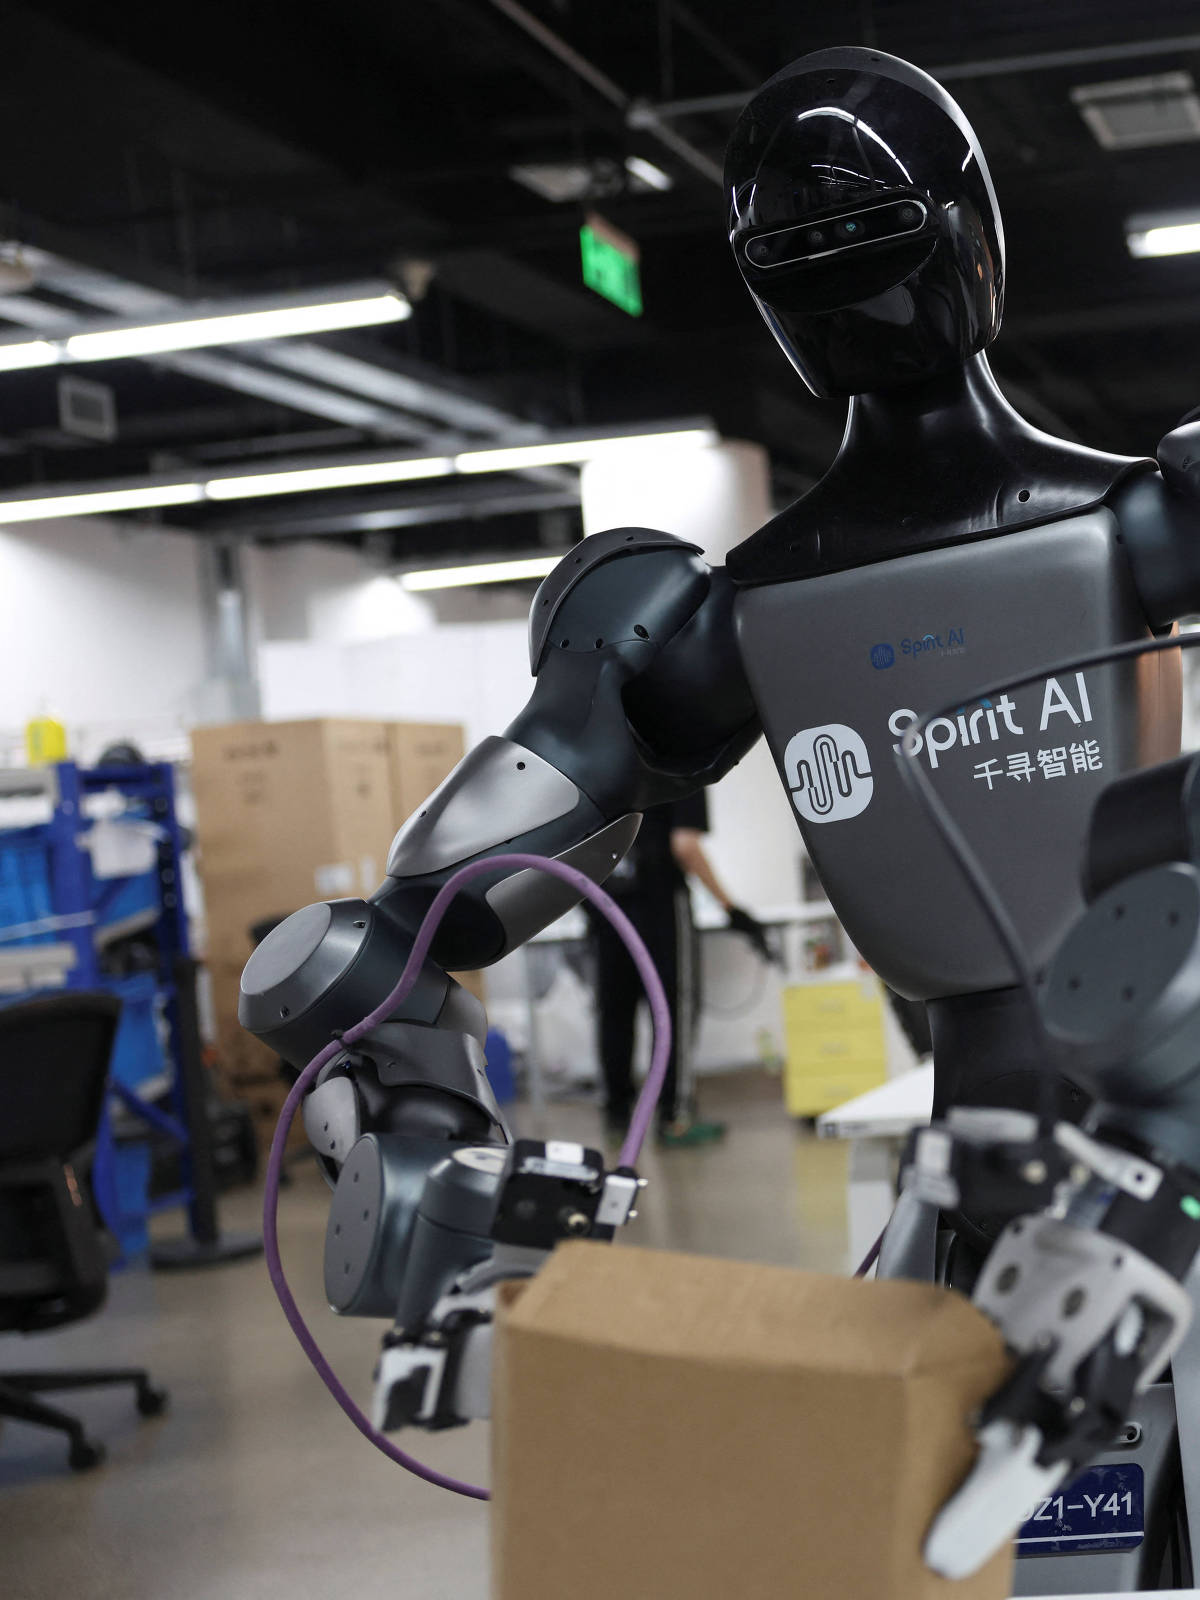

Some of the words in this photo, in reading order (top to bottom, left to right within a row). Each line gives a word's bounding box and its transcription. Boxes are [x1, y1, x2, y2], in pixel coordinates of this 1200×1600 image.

[901, 634, 944, 659] Spirit
[948, 627, 964, 647] AI
[888, 694, 1024, 769] Spirit
[1040, 671, 1093, 731] AI
[973, 739, 1103, 790] 千寻智能
